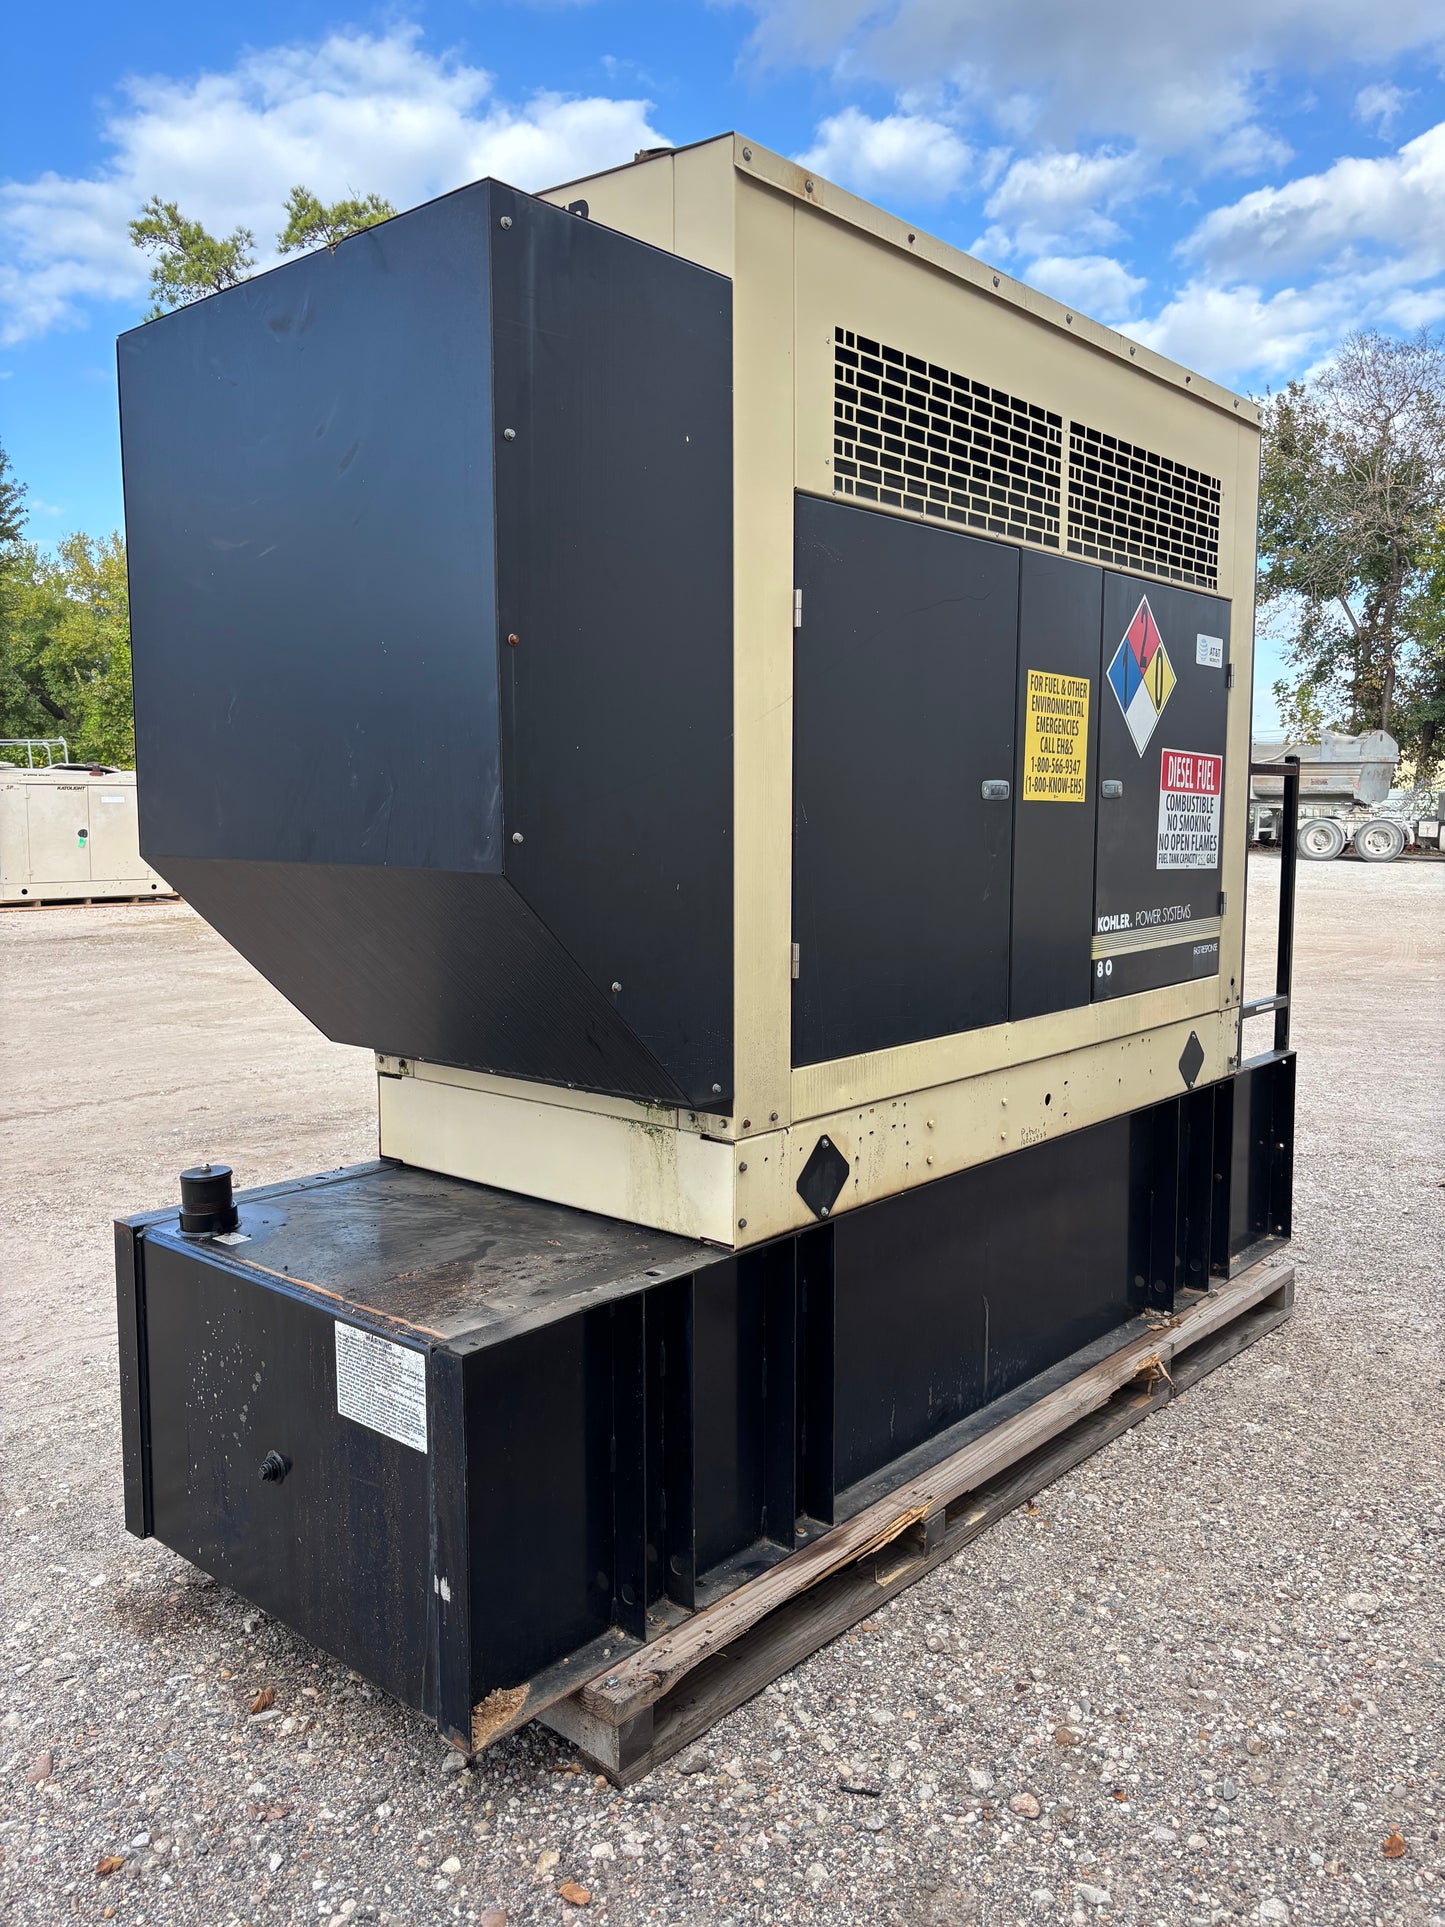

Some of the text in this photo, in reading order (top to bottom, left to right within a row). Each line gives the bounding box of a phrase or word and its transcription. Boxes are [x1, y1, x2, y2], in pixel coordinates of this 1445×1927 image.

[1140, 604, 1148, 668] 2
[1122, 642, 1128, 708] 1
[1155, 647, 1163, 710] 0
[1030, 674, 1087, 699] FOR FUEL & OTHER
[1031, 695, 1084, 718] ENVIRONMENTAL
[1036, 716, 1079, 736] EMERGENCIES
[1040, 737, 1073, 755] CALL EH&S
[1031, 757, 1081, 775] 1-800-566-9347
[1167, 755, 1215, 791] DIESEL FUEL
[1026, 775, 1083, 796] (1-800-KNOW-EHS)
[1166, 794, 1214, 814] COMBUSTIBLE
[1167, 814, 1211, 832] NO SMOKING
[1159, 833, 1217, 852] NO OPEN FLAMES
[1158, 853, 1168, 864] FUEL
[1169, 853, 1179, 864] TANK
[1180, 853, 1197, 864] CAPACITY
[1206, 853, 1216, 864] GALS
[1135, 908, 1161, 926] POWER
[1162, 903, 1192, 923] SYSTEMS
